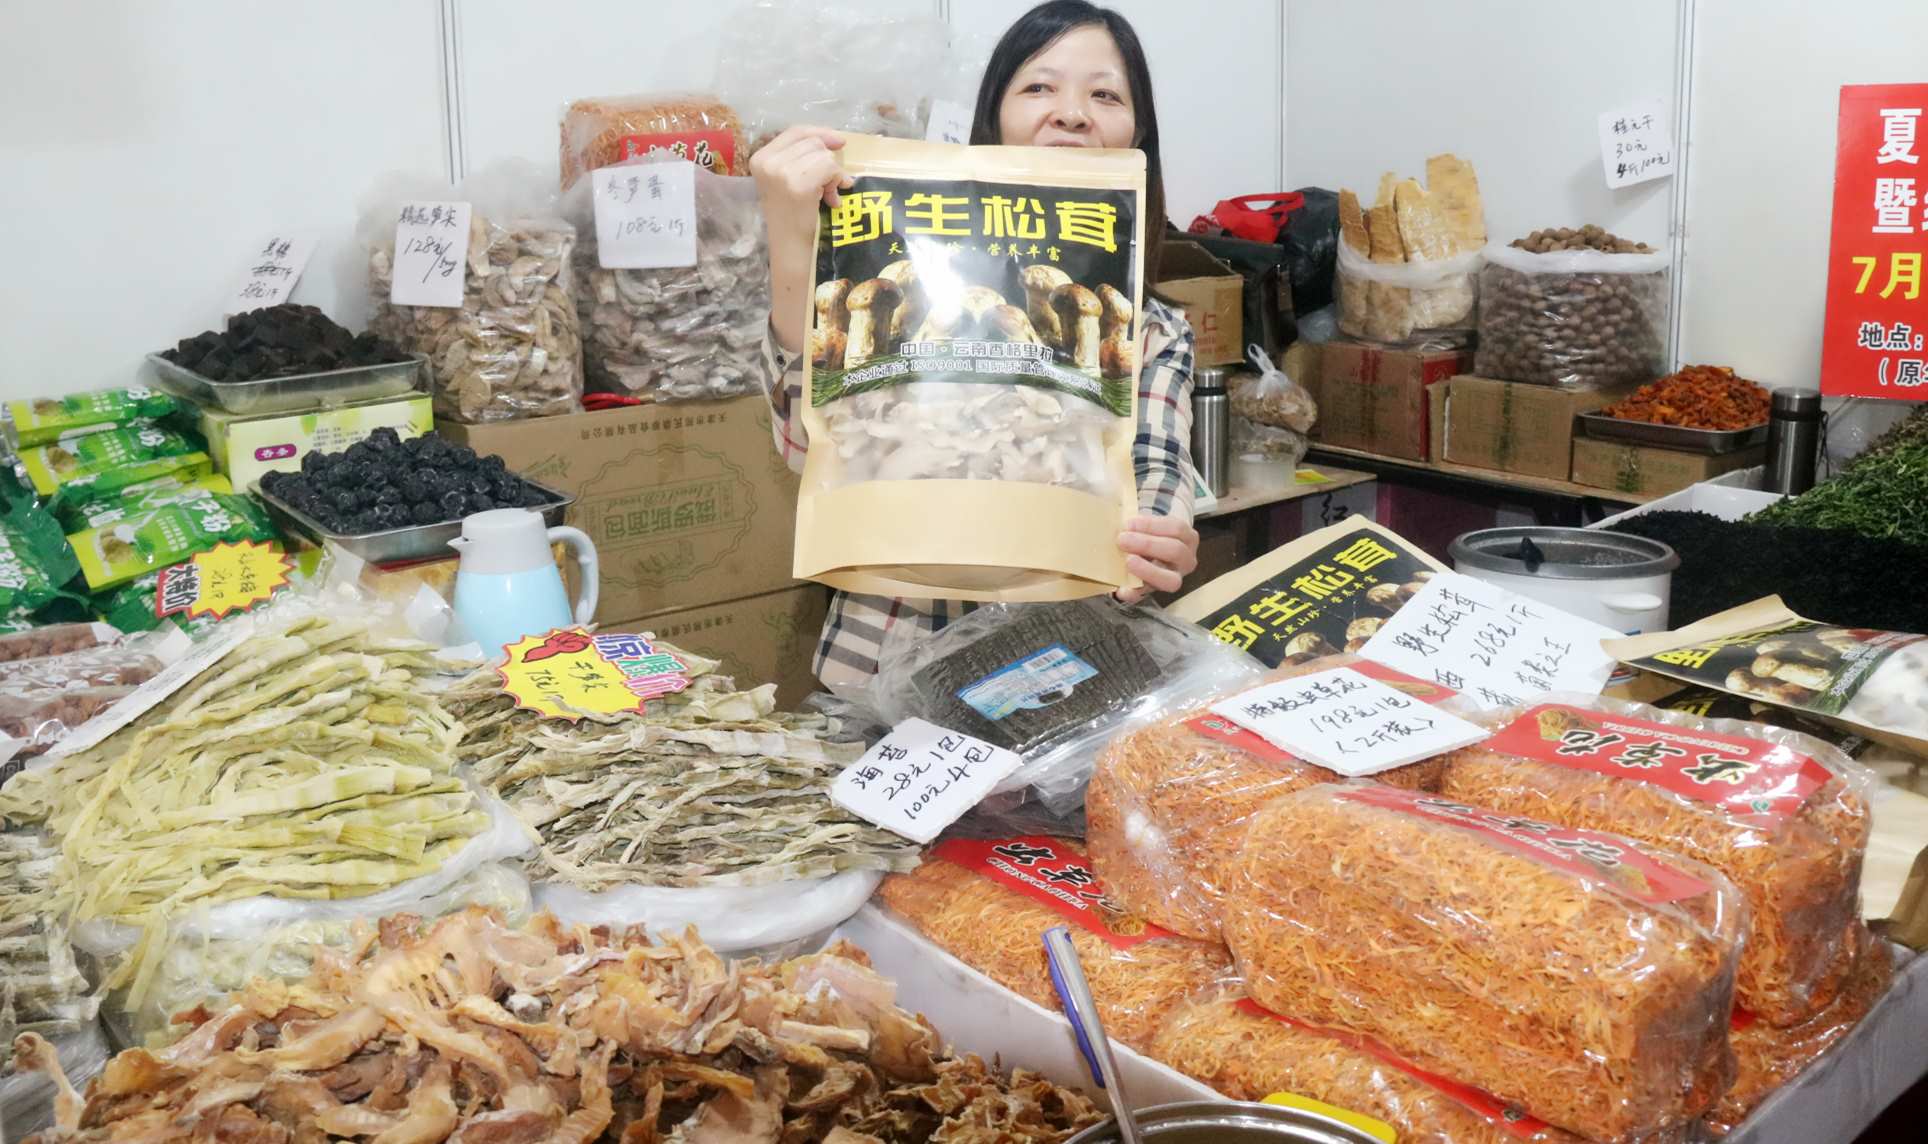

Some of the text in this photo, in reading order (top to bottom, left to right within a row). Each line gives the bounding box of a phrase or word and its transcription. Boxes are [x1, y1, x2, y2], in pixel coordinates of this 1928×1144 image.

[1876, 108, 1922, 165] 夏
[831, 191, 1118, 253] 野生松茸
[1872, 178, 1928, 234] 暨
[1852, 252, 1921, 299] 7月
[1878, 357, 1928, 387] （原
